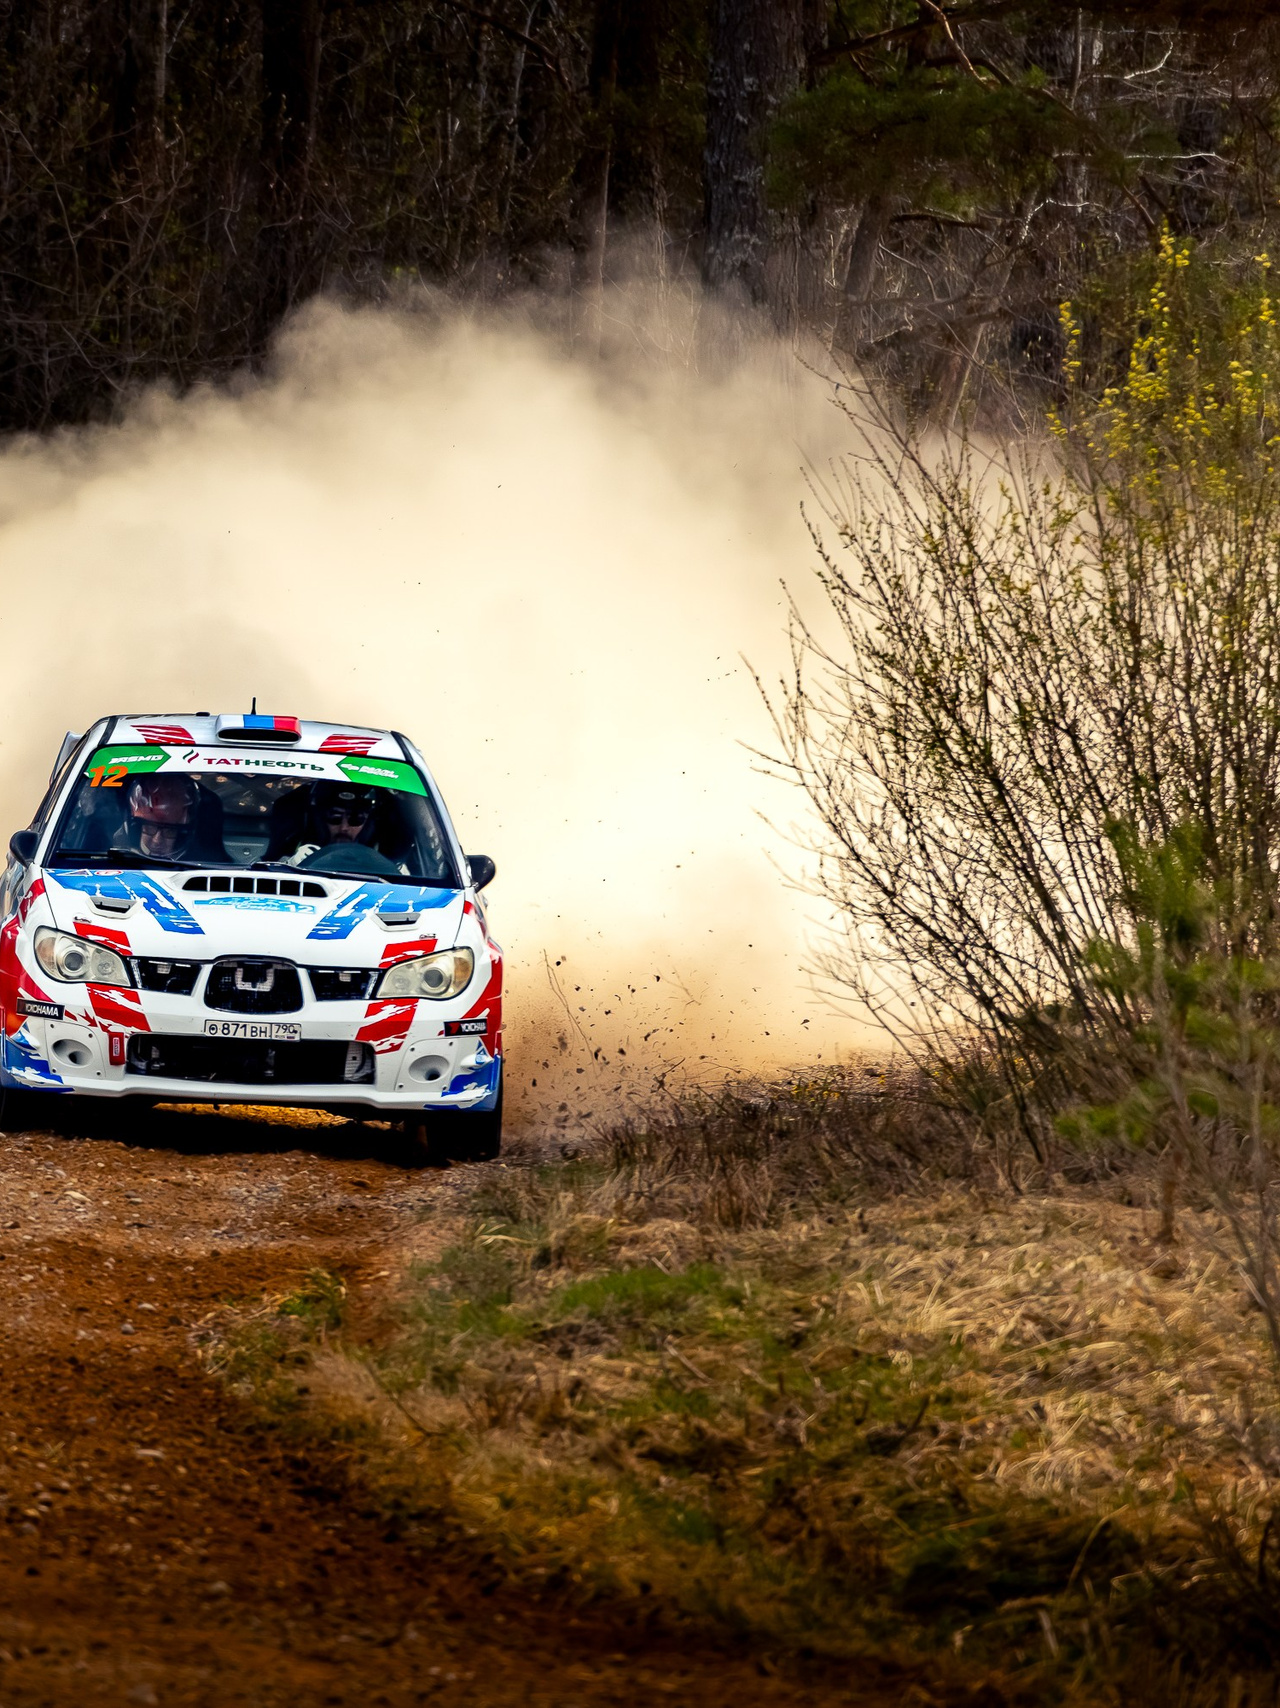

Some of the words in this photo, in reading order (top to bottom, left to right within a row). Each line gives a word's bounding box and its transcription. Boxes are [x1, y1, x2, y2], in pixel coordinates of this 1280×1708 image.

[203, 757, 325, 772] ТАТНЕФТЬ
[90, 765, 129, 787] 12
[284, 903, 315, 914] 12
